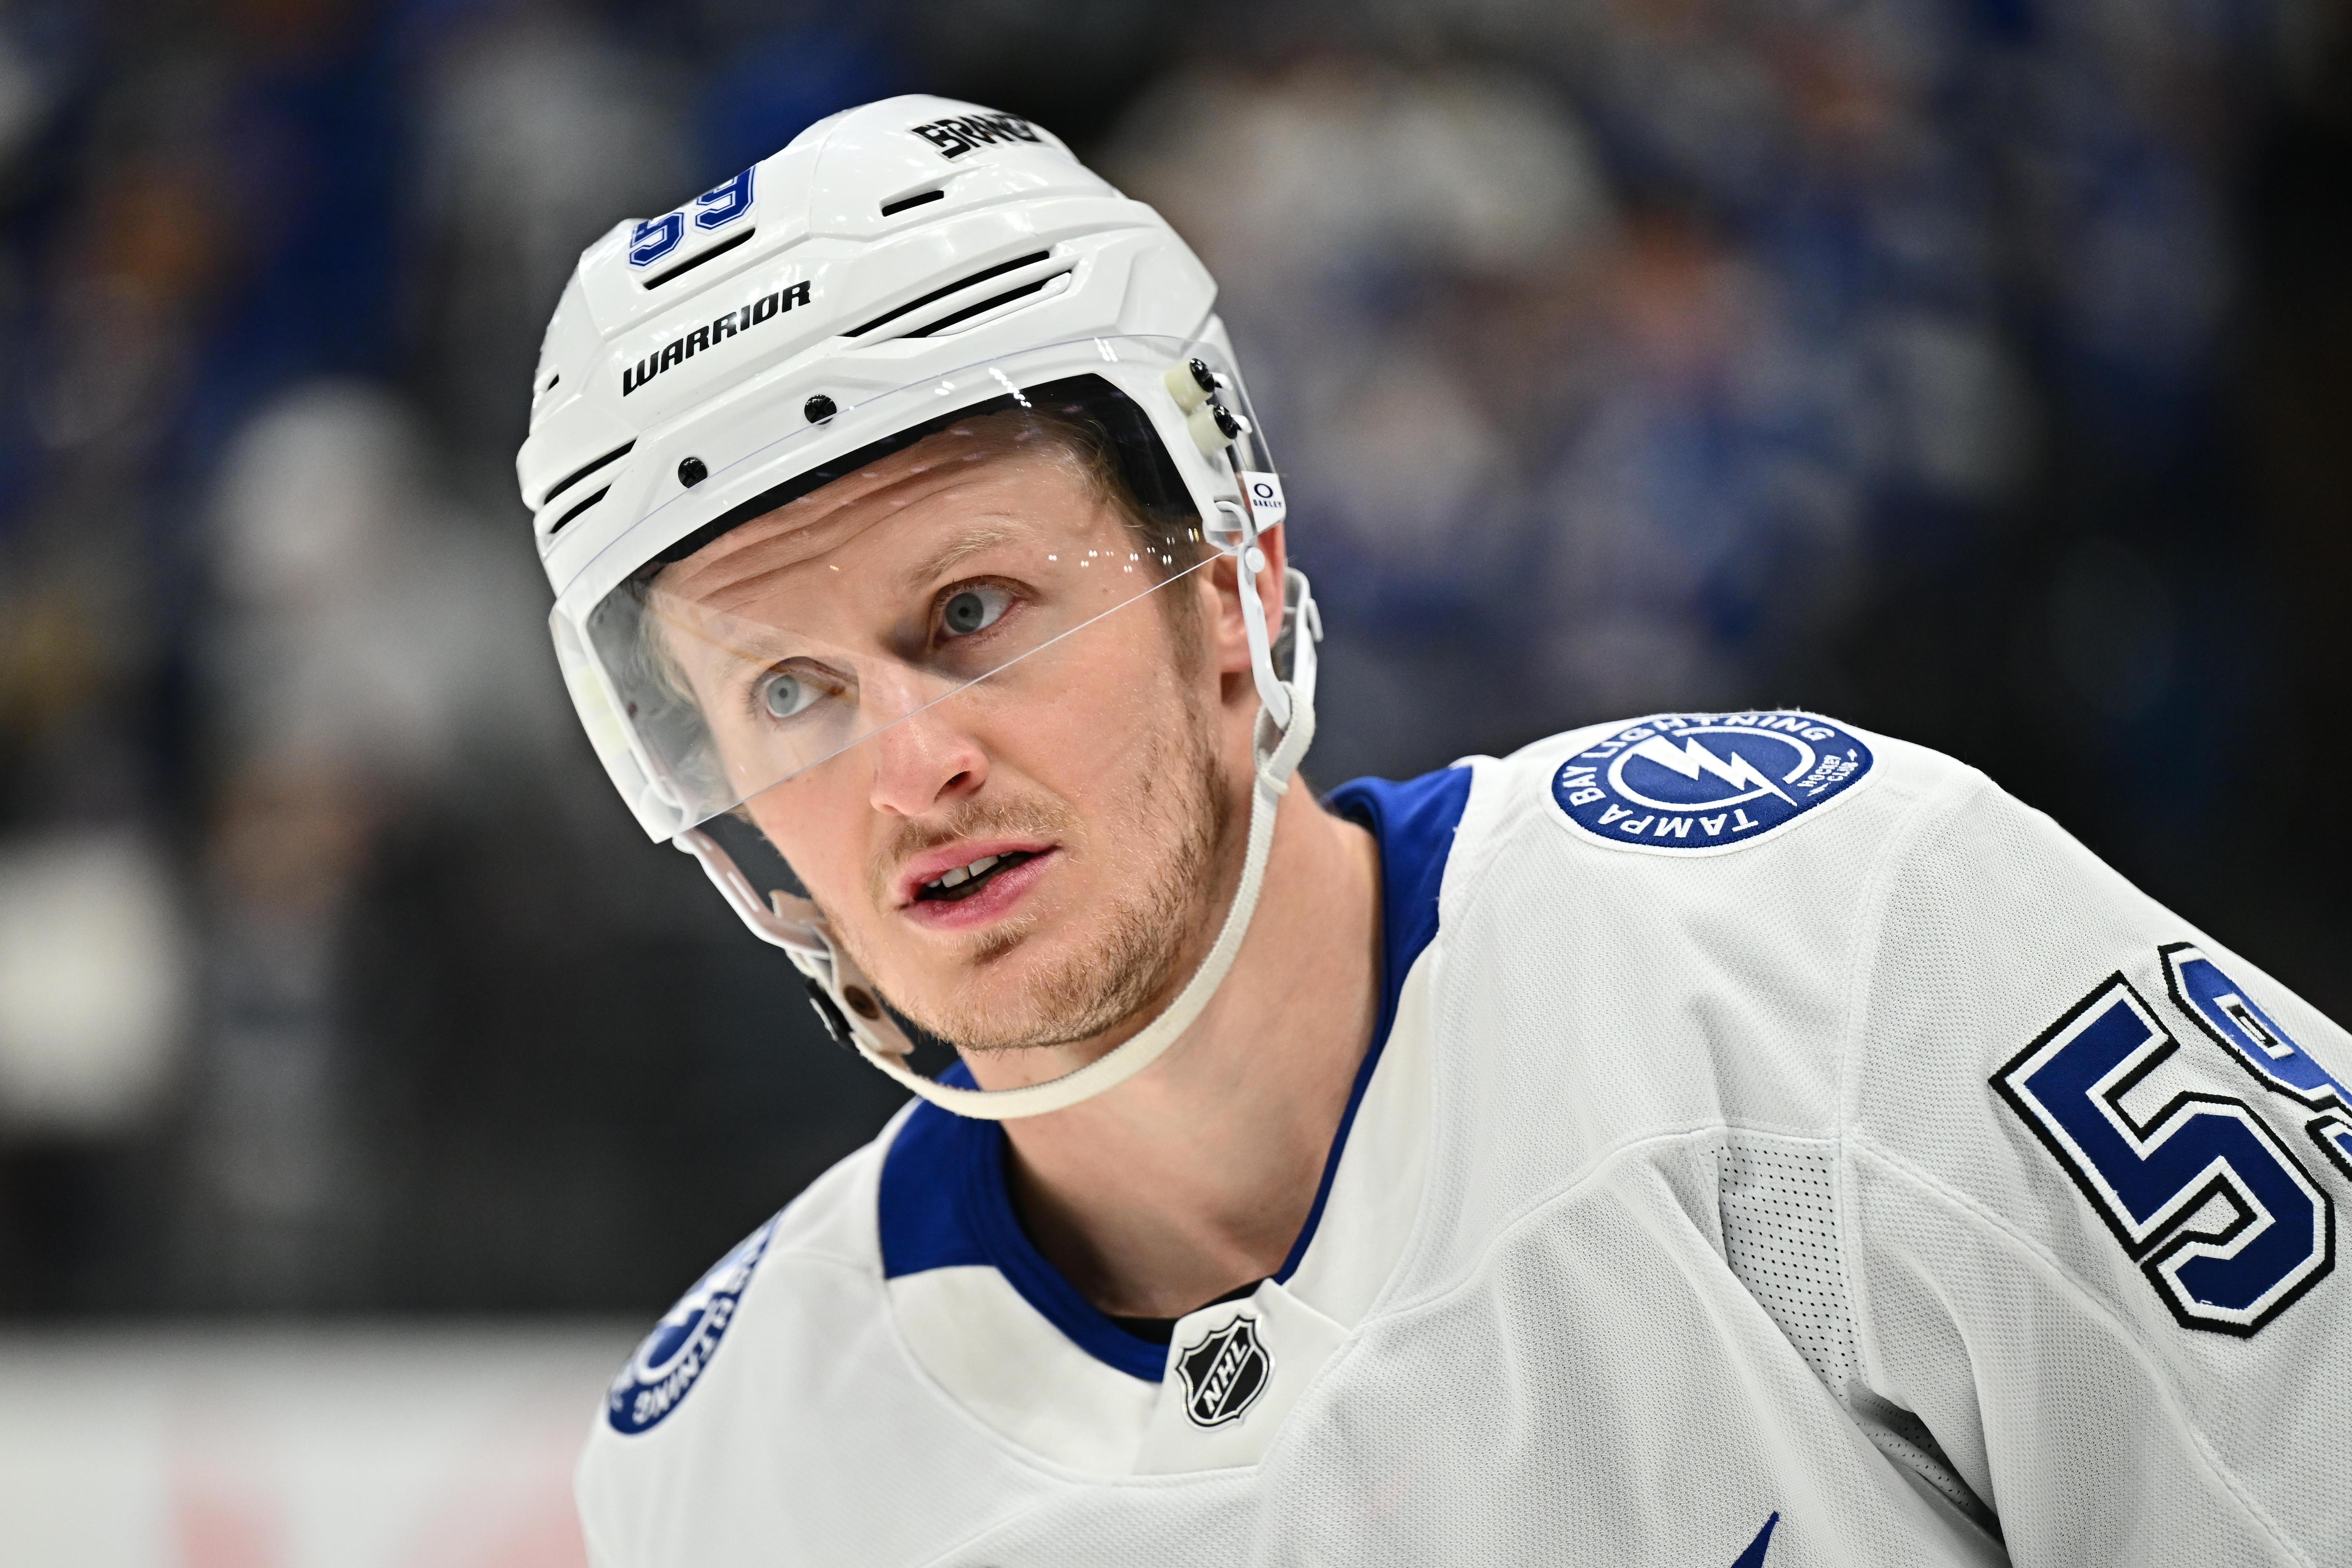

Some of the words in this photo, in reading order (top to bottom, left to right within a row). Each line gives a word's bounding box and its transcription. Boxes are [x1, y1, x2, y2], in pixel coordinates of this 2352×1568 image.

[630, 166, 756, 267] 59
[623, 280, 811, 397] WARRIOR
[1253, 499, 1282, 508] OAKLEY
[1581, 714, 1835, 759] LIGHTNING
[1563, 766, 1606, 807] BAY
[1597, 803, 1759, 838] TAMPA
[1202, 1340, 1248, 1414] NHL
